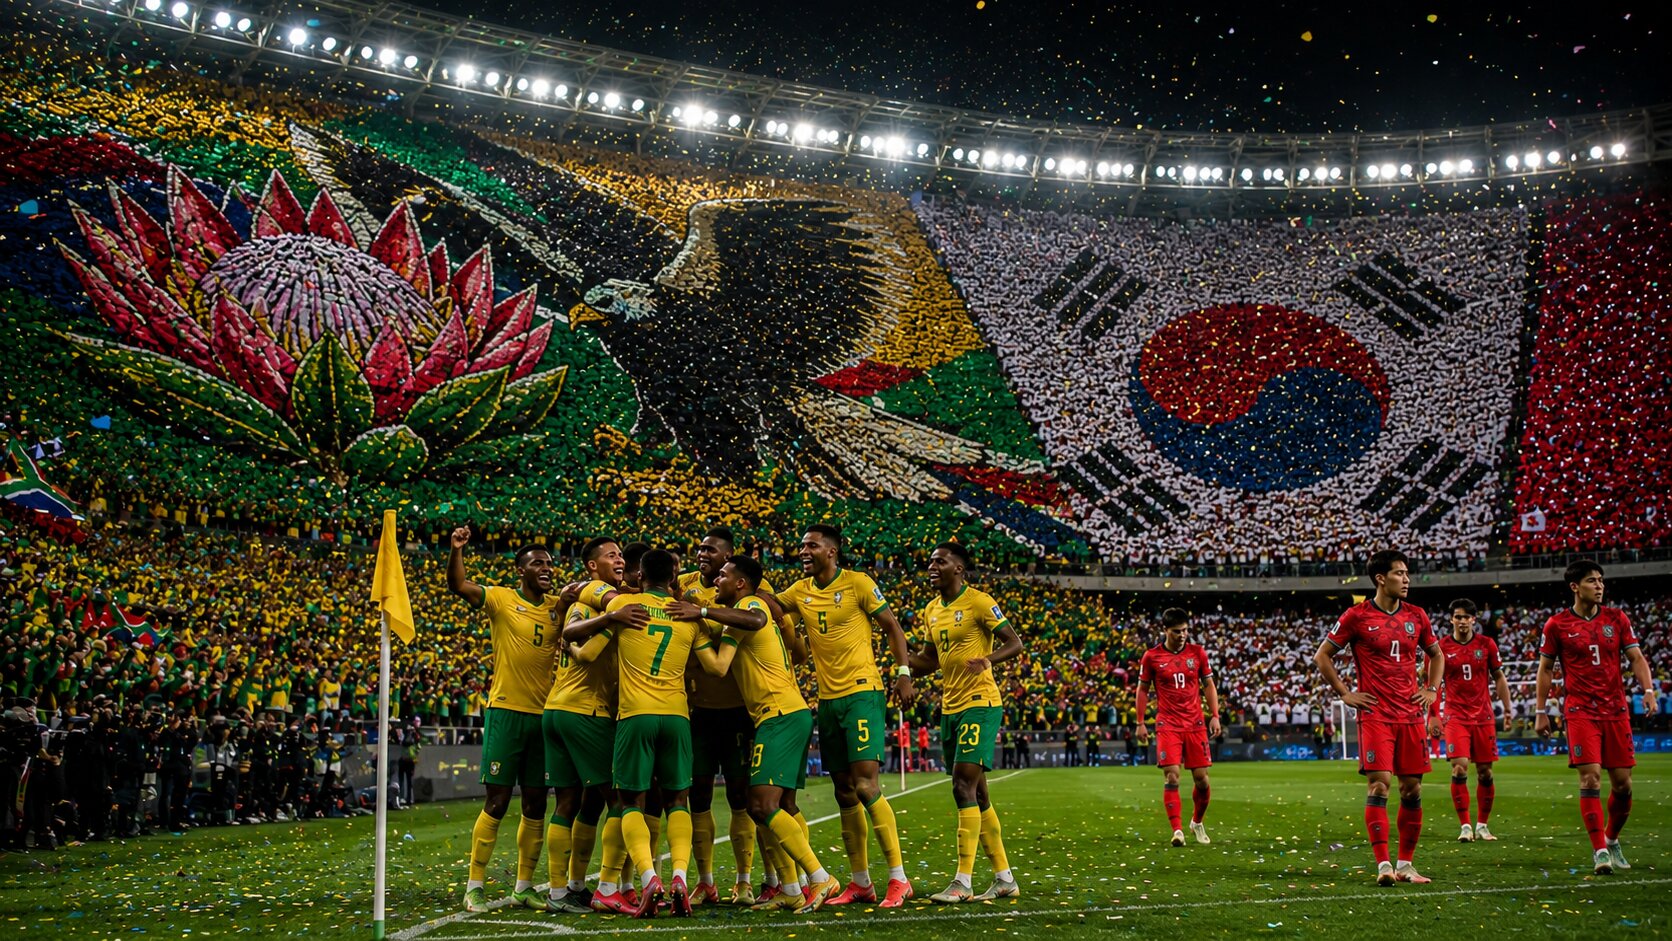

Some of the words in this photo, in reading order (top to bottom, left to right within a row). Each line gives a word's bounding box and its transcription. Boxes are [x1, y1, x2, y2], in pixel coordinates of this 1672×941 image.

[818, 611, 827, 634] 5
[533, 623, 544, 647] 5
[648, 624, 673, 676] 7
[1390, 640, 1400, 662] 4
[1589, 645, 1600, 665] 3
[1173, 672, 1185, 689] 19
[1462, 664, 1472, 680] 9
[857, 719, 870, 743] 5
[959, 723, 981, 746] 23
